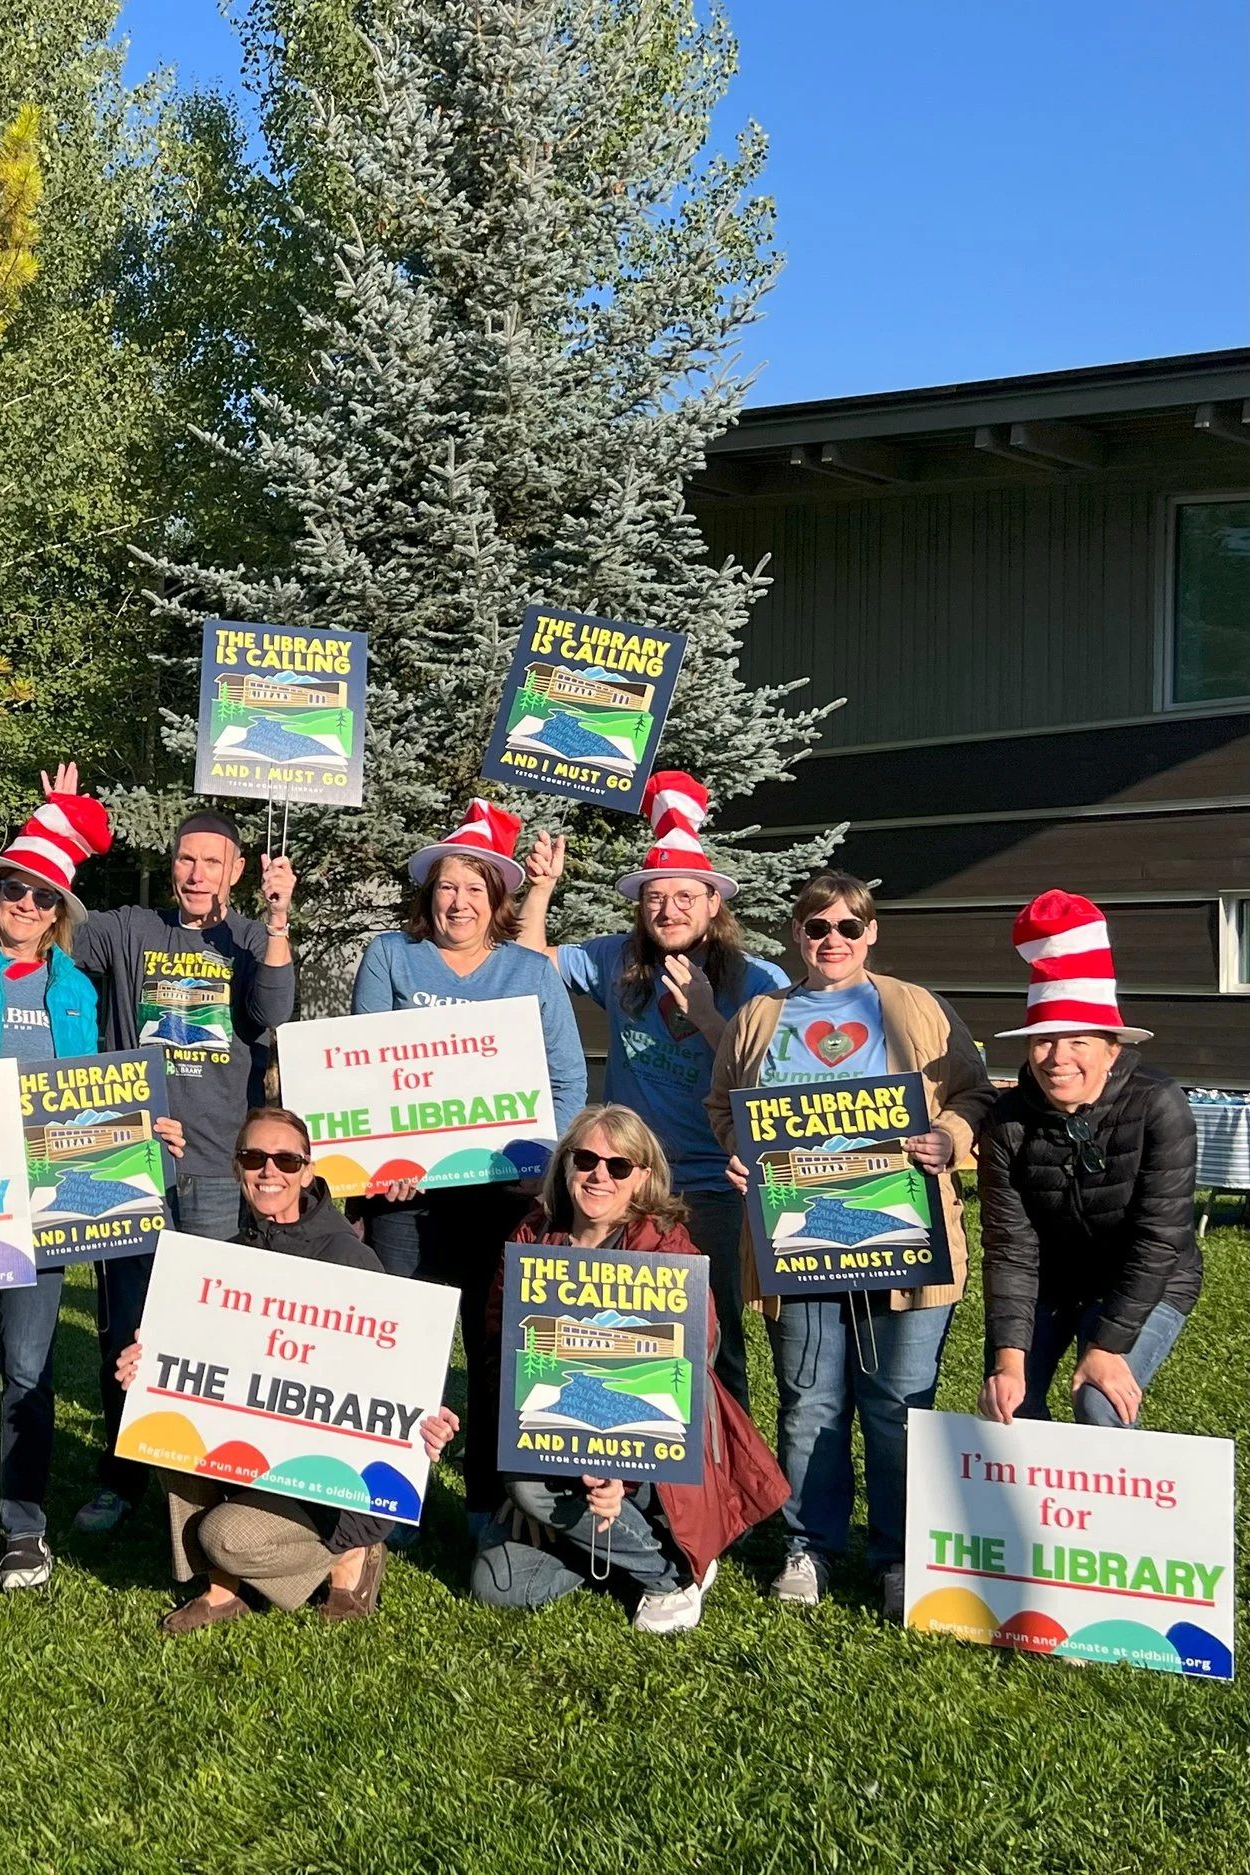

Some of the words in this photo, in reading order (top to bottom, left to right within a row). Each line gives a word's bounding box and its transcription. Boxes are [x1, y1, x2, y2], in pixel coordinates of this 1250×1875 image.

[216, 630, 255, 649] THE
[263, 634, 351, 657] LIBRARY
[537, 616, 576, 639] THE
[580, 625, 670, 658] LIBRARY
[216, 645, 237, 665] IS
[246, 649, 351, 675] CALLING
[531, 633, 554, 654] IS
[560, 639, 664, 678] CALLING
[211, 763, 249, 777] AND
[255, 767, 260, 779] I
[269, 768, 315, 784] MUST
[322, 772, 347, 786] GO
[500, 751, 538, 770] AND
[542, 759, 549, 772] I
[554, 763, 600, 785] MUST
[606, 775, 631, 792] GO
[516, 770, 538, 780] TETON
[541, 776, 571, 787] COUNTY
[574, 783, 605, 795] LIBRARY
[144, 951, 169, 963] THE
[161, 962, 234, 979] CALLING
[174, 1050, 206, 1061] MUST
[211, 1053, 230, 1063] GO
[324, 1047, 370, 1069] I'm
[379, 1034, 498, 1064] running
[774, 1028, 792, 1061] I
[20, 1073, 49, 1094] HE
[56, 1061, 148, 1089] LIBRARY
[392, 1068, 434, 1091] for
[763, 1068, 863, 1082] Summer
[42, 1081, 150, 1113] CALLING
[745, 1097, 793, 1120] THE
[800, 1085, 906, 1116] LIBRARY
[305, 1107, 371, 1140] THE
[390, 1089, 541, 1133] LIBRARY
[751, 1118, 777, 1142] IS
[785, 1106, 910, 1137] CALLING
[377, 1176, 393, 1187] run
[421, 1170, 460, 1182] donate
[463, 1169, 475, 1179] at
[33, 1229, 65, 1248] AND
[72, 1226, 77, 1242] I
[85, 1220, 132, 1240] MUST
[140, 1215, 165, 1232] GO
[46, 1247, 73, 1256] TETON
[75, 1242, 107, 1252] COUNTY
[111, 1237, 143, 1247] LIBRARY
[520, 1257, 569, 1281] THE
[578, 1260, 689, 1289] LIBRARY
[775, 1256, 818, 1273] AND
[825, 1255, 831, 1269] I
[840, 1251, 894, 1269] MUST
[903, 1248, 932, 1265] GO
[798, 1274, 826, 1282] TETON
[829, 1272, 866, 1280] COUNTY
[869, 1269, 907, 1278] LIBRARY
[520, 1279, 547, 1304] IS
[558, 1281, 688, 1314] CALLING
[198, 1277, 251, 1313] I'm
[260, 1296, 398, 1350] running
[265, 1329, 315, 1365] for
[156, 1353, 230, 1402] THE
[246, 1373, 424, 1441] LIBRARY
[517, 1432, 565, 1452] AND
[572, 1436, 578, 1453] I
[587, 1437, 646, 1458] MUST
[654, 1443, 686, 1461] GO
[540, 1455, 569, 1463] TETON
[574, 1457, 612, 1467] COUNTY
[616, 1460, 656, 1470] LIBRARY
[137, 1443, 191, 1463] Register
[194, 1455, 207, 1468] to
[210, 1460, 232, 1473] run
[235, 1464, 260, 1478] and
[262, 1471, 305, 1490] donate
[308, 1481, 323, 1494] at
[326, 1484, 398, 1511] oldbills.org
[961, 1452, 1015, 1484] I'm
[1027, 1467, 1177, 1509] running
[1040, 1498, 1092, 1531] for
[929, 1529, 1006, 1573] THE
[1032, 1543, 1226, 1600] LIBRARY
[988, 1627, 1002, 1639] to
[1005, 1631, 1029, 1644] run
[1032, 1633, 1058, 1647] and
[1062, 1639, 1109, 1655] donate
[1113, 1644, 1128, 1657] at
[1132, 1649, 1212, 1671] oldbills.org
